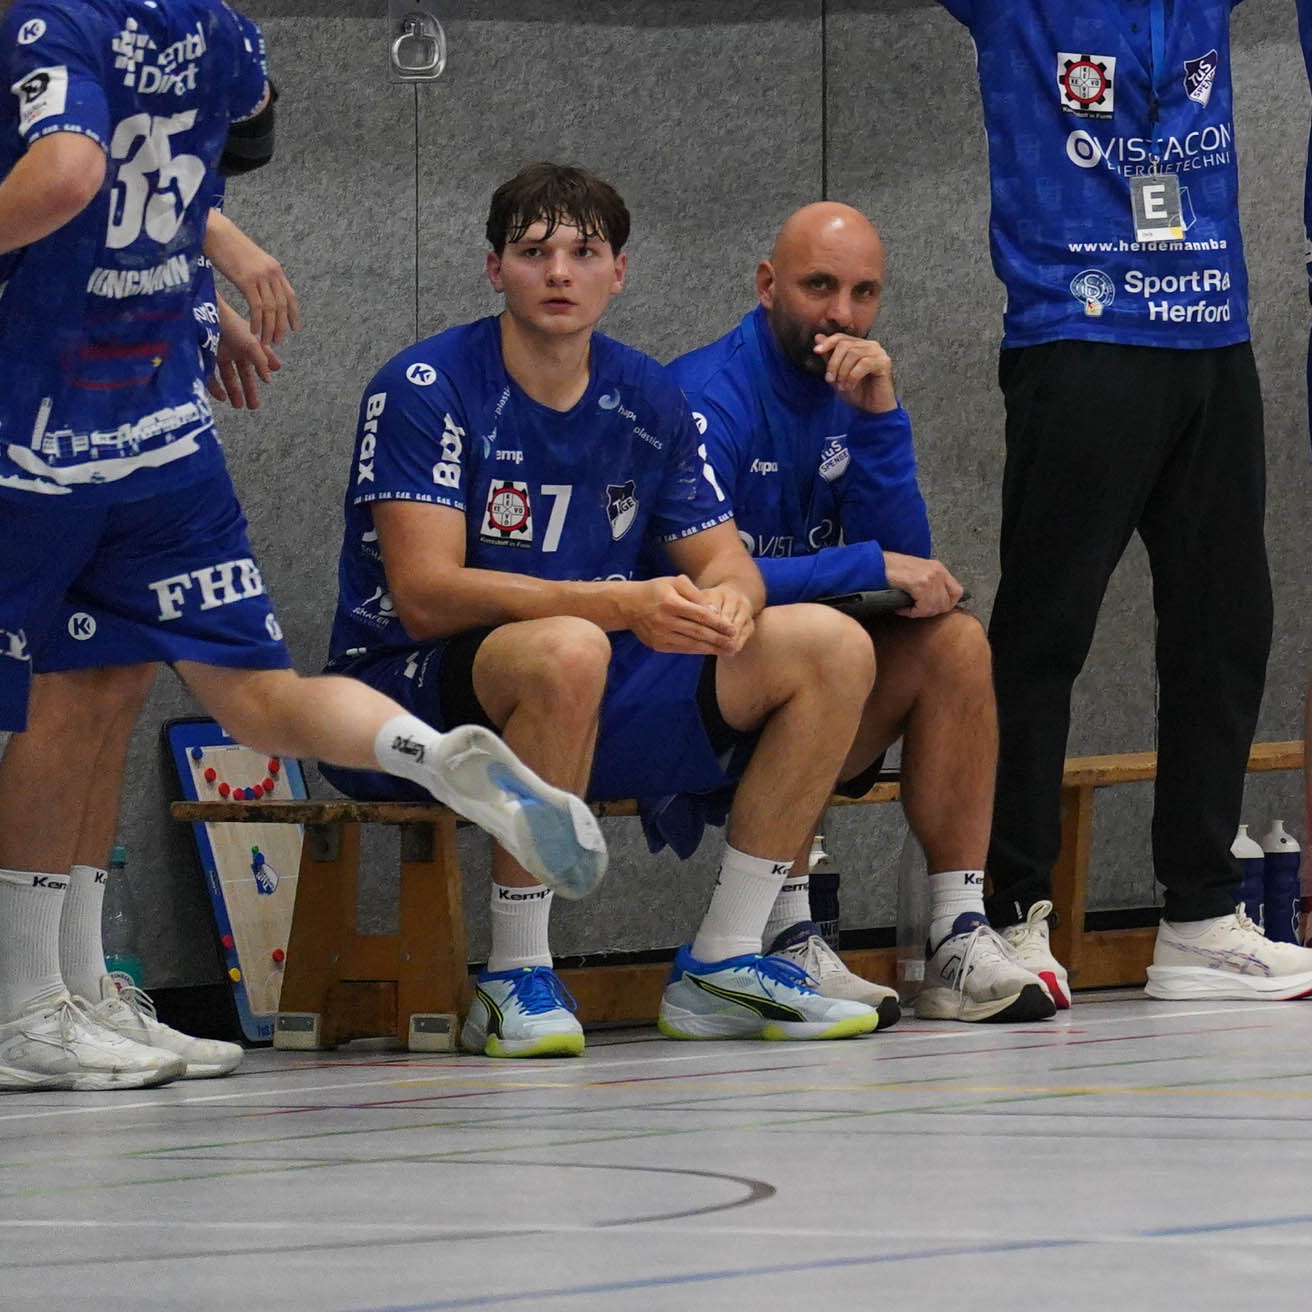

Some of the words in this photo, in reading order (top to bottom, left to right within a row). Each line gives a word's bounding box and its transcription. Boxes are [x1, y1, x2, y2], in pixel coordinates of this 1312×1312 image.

[1093, 123, 1231, 163] VISACON
[1142, 184, 1167, 219] E
[496, 449, 524, 465] emp
[540, 484, 573, 553] 7
[499, 888, 551, 901] Kemp
